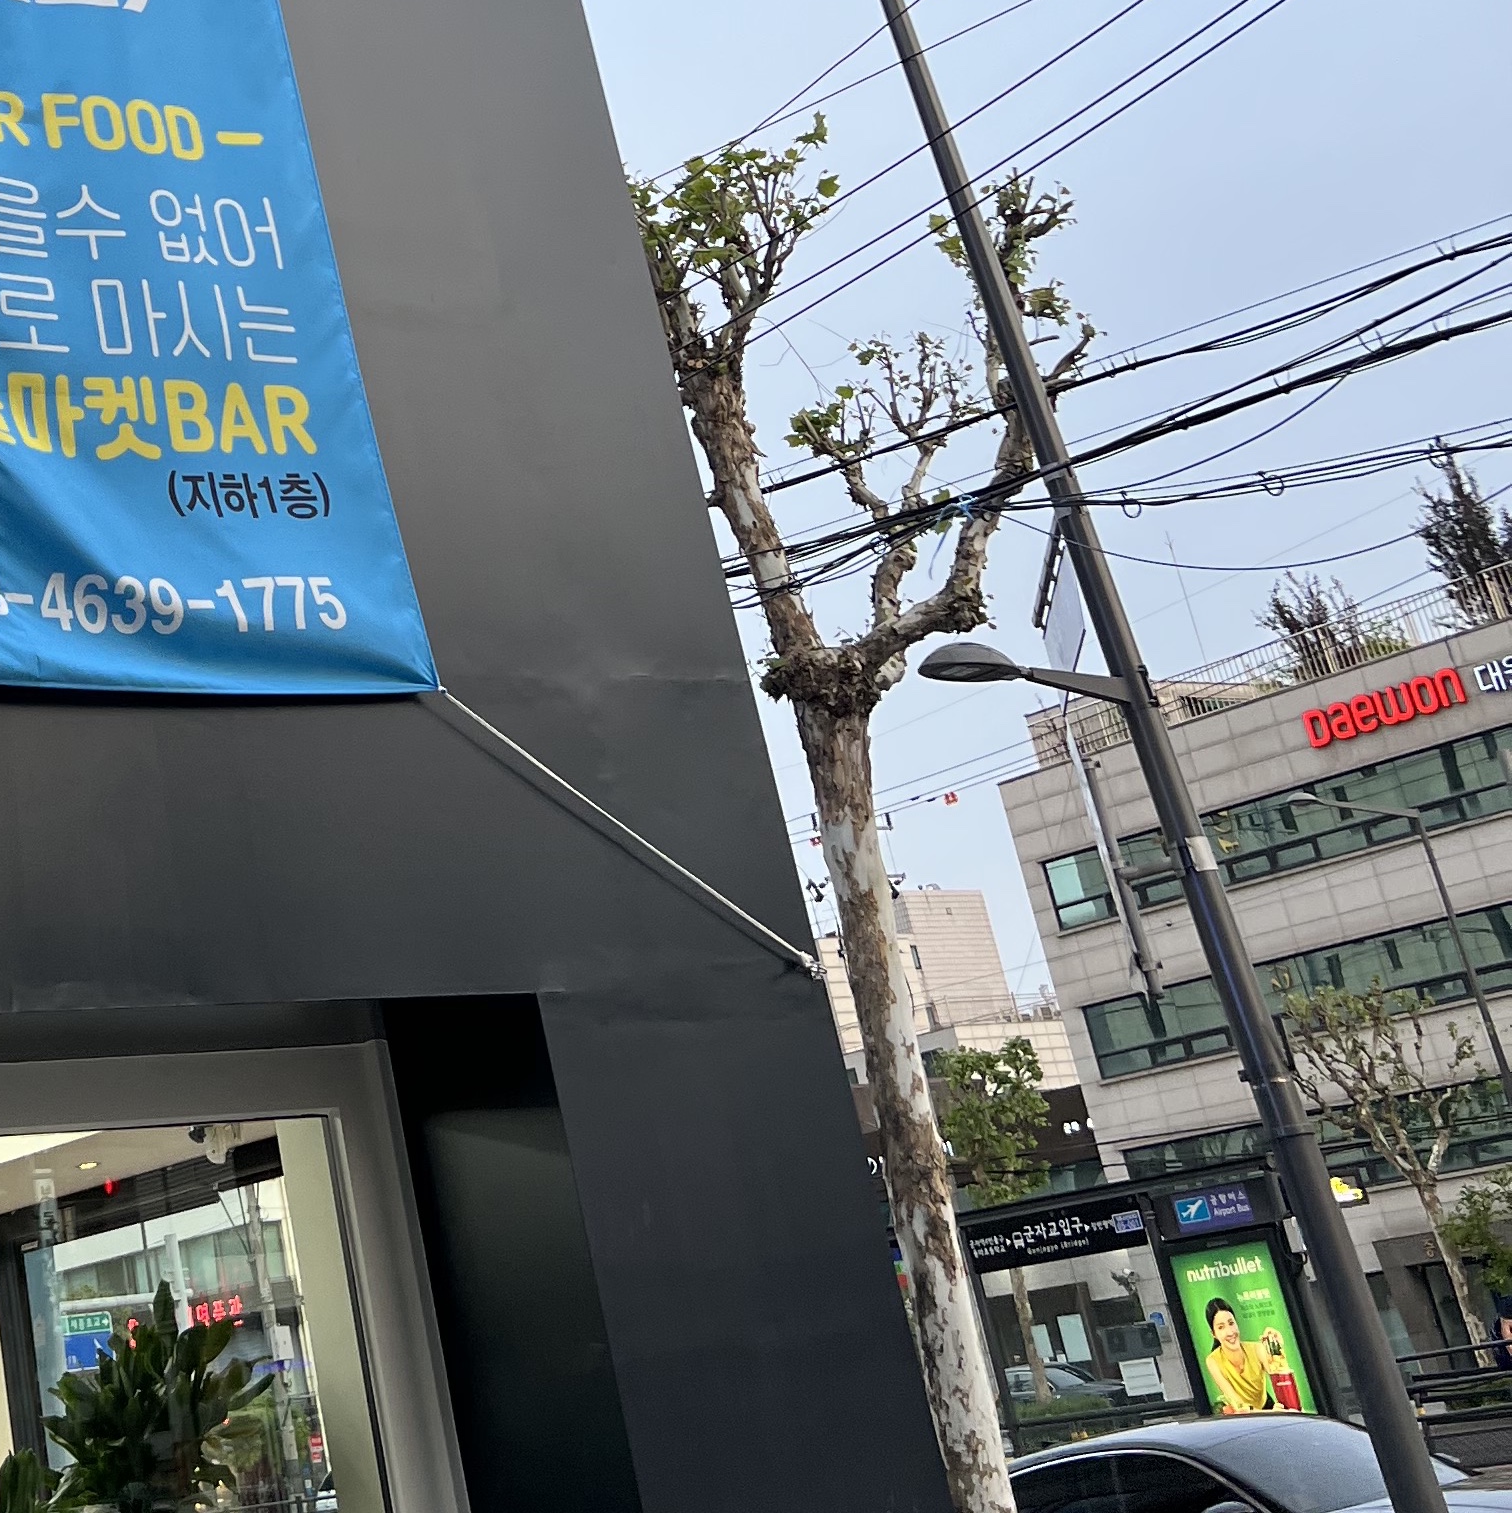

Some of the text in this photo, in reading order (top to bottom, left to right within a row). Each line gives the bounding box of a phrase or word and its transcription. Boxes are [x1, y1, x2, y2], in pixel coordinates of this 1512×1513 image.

[42, 94, 204, 160] FOOD
[149, 189, 285, 269] 없어
[93, 278, 298, 364] 마시는
[167, 469, 332, 520] (지하1층)
[1023, 1216, 1083, 1244] 군자교입구
[1214, 1203, 1250, 1217] Airport Bus
[1186, 1256, 1264, 1282] nutribullet
